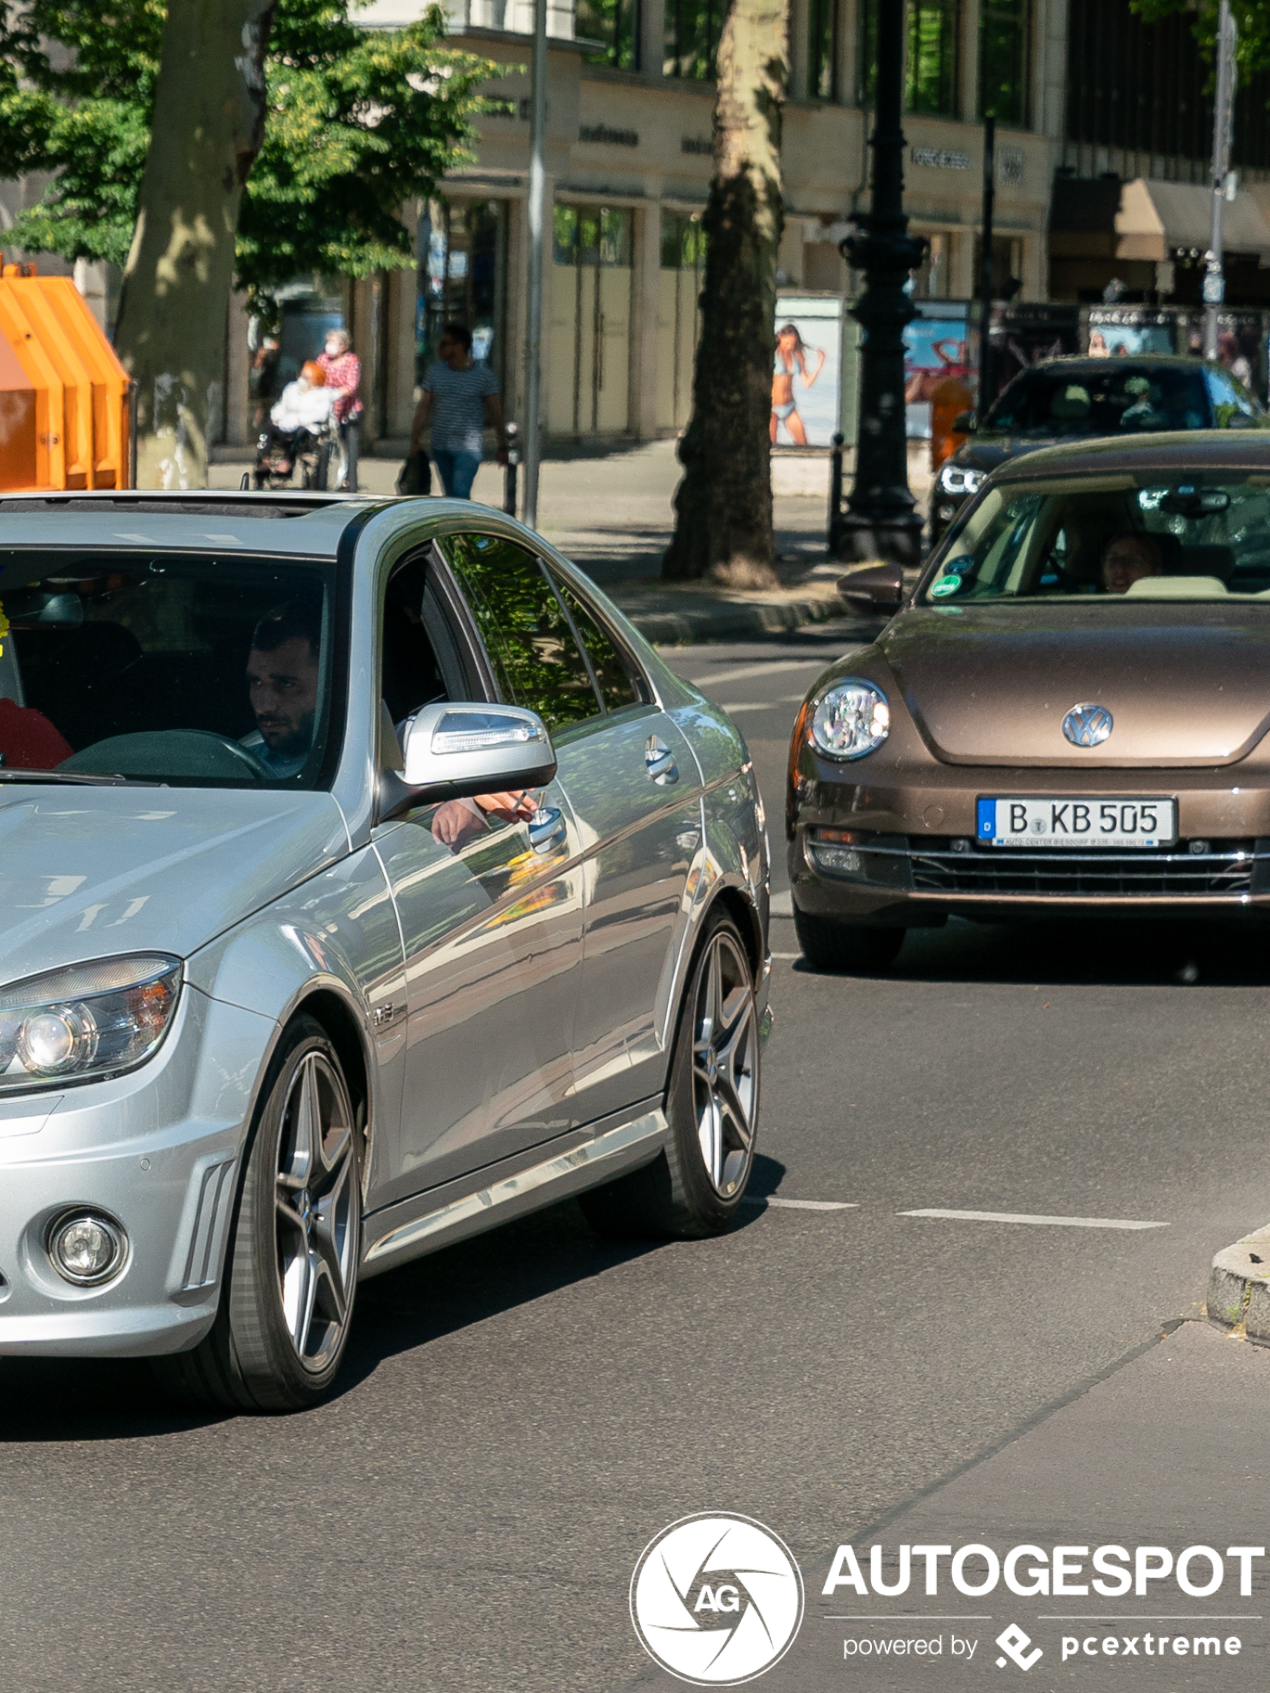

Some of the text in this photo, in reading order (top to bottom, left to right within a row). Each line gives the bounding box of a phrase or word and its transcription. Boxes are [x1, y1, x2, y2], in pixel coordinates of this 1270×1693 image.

[983, 822, 991, 832] D
[1010, 803, 1158, 834] B KB 505
